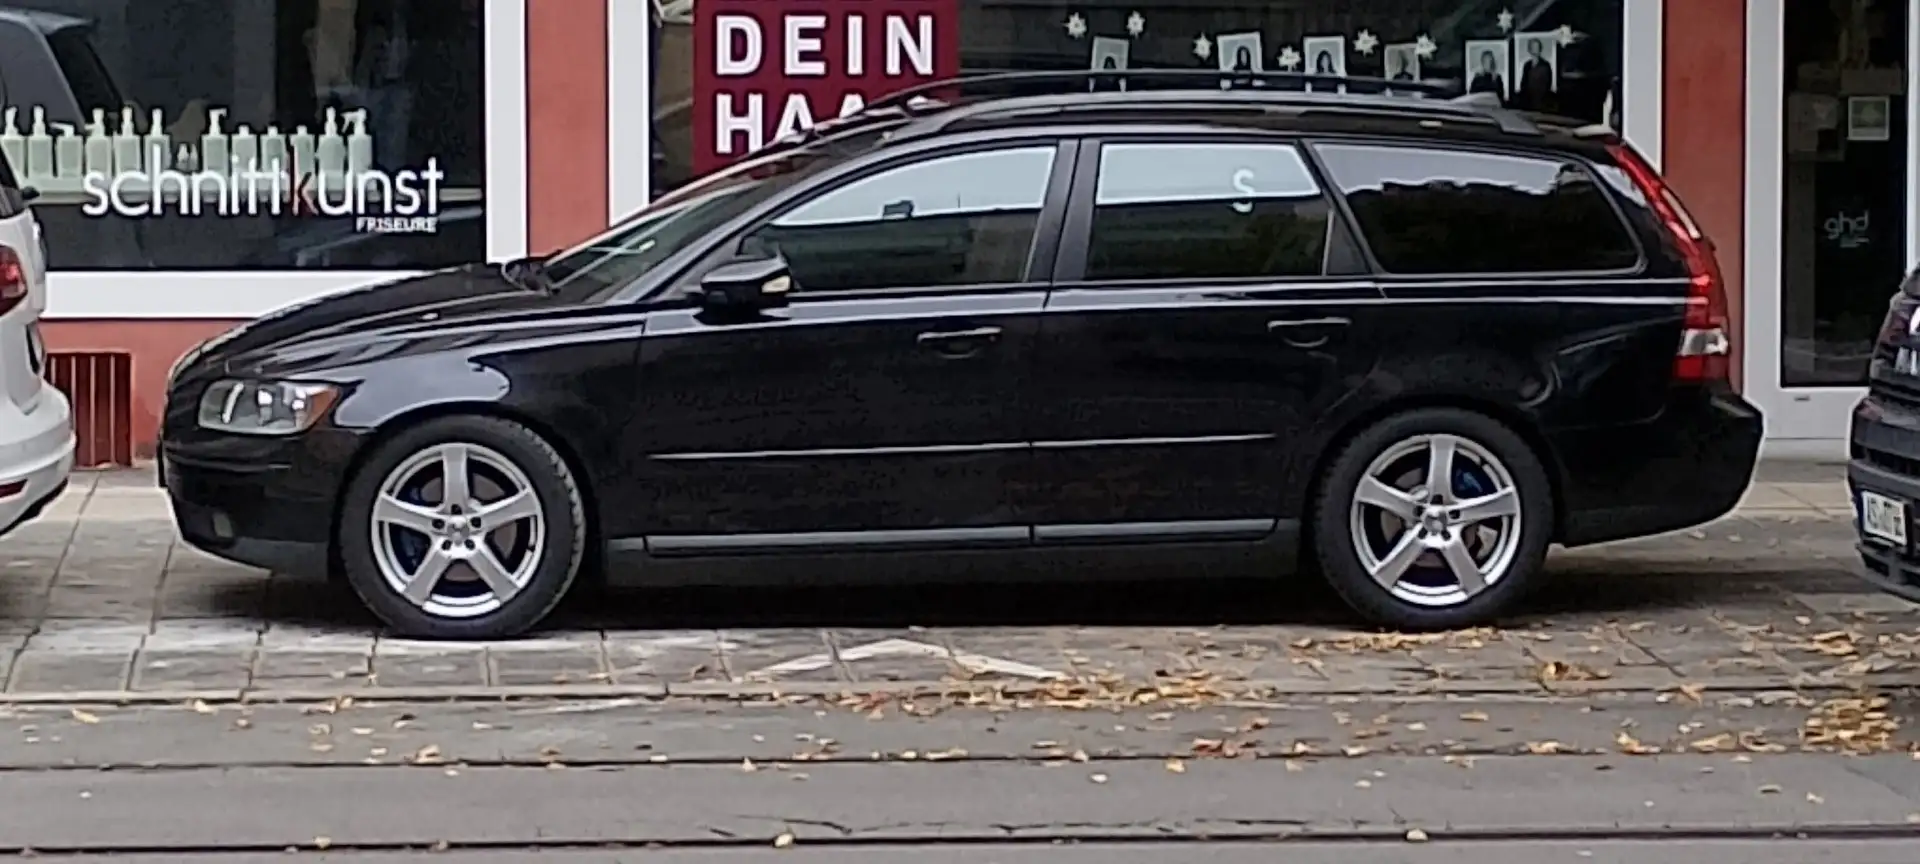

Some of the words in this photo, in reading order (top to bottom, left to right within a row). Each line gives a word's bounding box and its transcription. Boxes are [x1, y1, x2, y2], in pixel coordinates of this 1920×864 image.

[716, 15, 934, 75] DEIN
[83, 142, 444, 216] schnittkunst
[356, 216, 438, 233] FRISEURE
[1824, 210, 1869, 240] ghd
